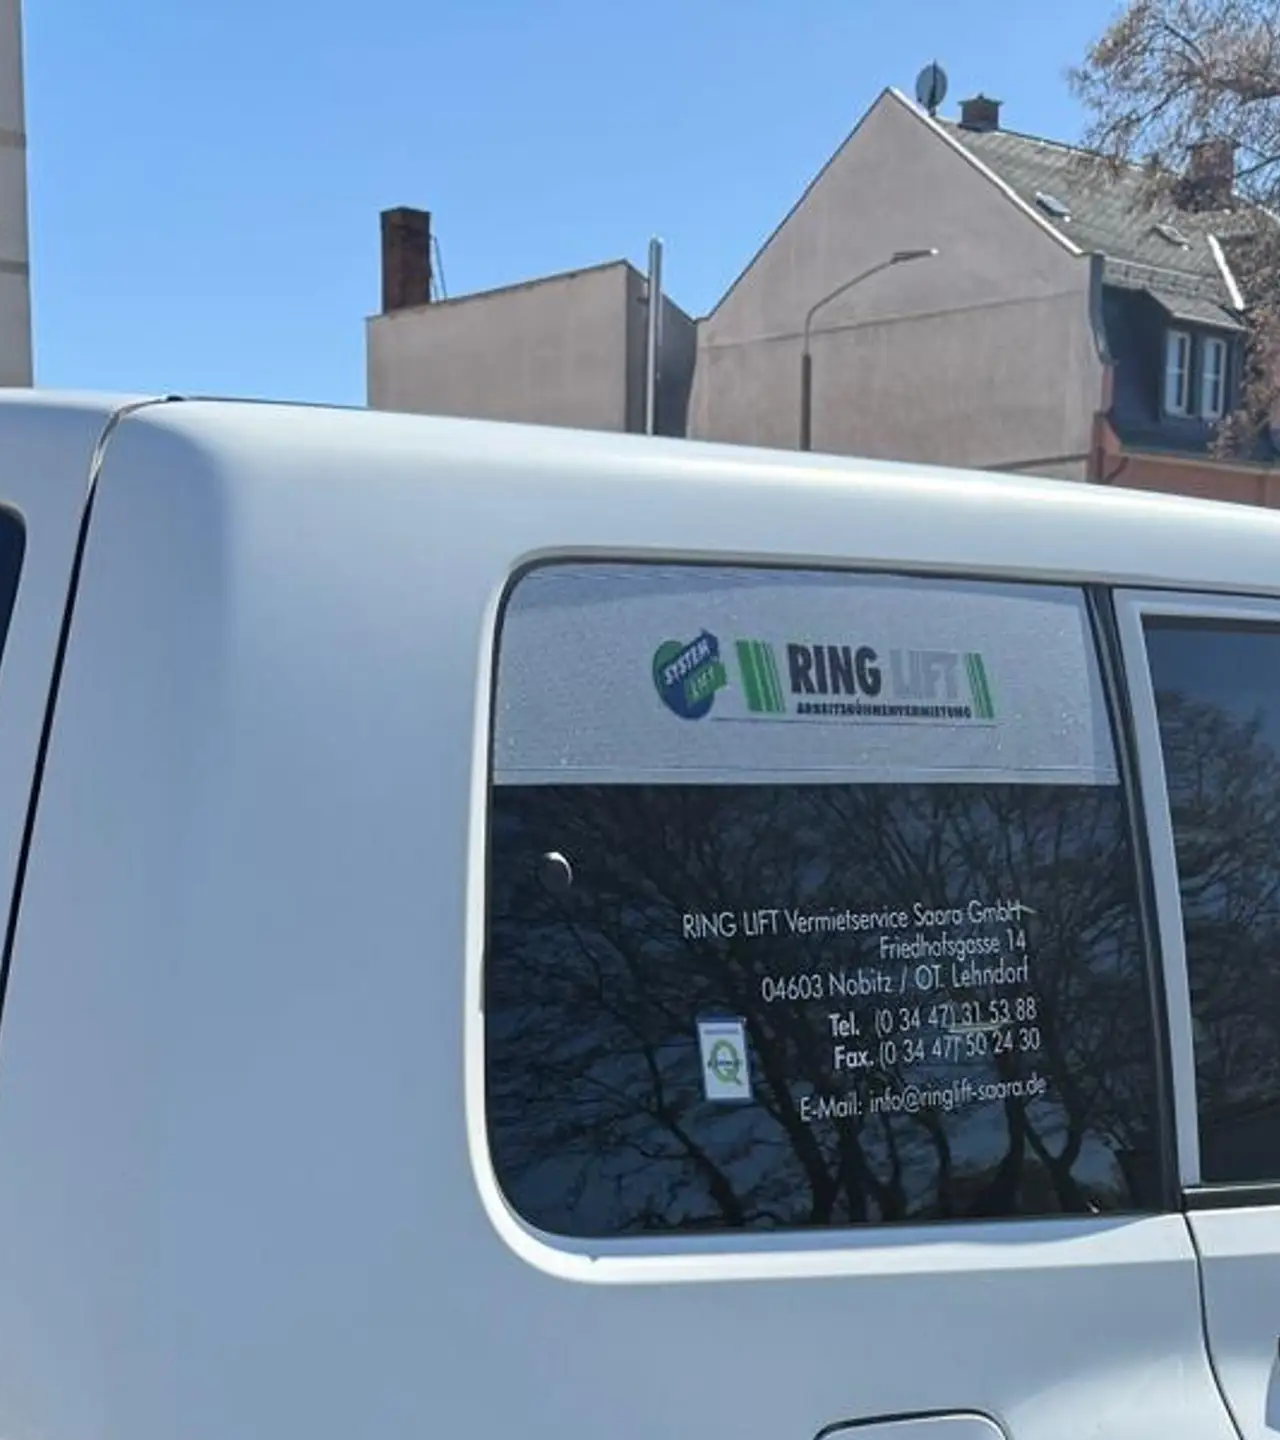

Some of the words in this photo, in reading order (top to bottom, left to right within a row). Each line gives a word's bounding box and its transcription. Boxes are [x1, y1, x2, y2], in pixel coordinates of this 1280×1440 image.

[664, 639, 710, 685] SYSTEM
[787, 643, 881, 697] RING
[889, 648, 960, 699] LIFT
[682, 911, 738, 939] RING
[743, 908, 780, 936] LIFT
[784, 905, 908, 934] Vermietservice
[913, 902, 963, 926] Saara
[968, 899, 1022, 924] GmbH
[1006, 927, 1026, 951] 14
[761, 973, 823, 1002] 04603
[829, 966, 893, 996] Nobitz
[898, 964, 908, 995] /
[951, 953, 1029, 988] Lehndorf
[829, 1011, 860, 1037] Tel.
[875, 1009, 894, 1038] (0
[899, 1007, 920, 1032] 34
[961, 1001, 981, 1026] 31
[989, 998, 1011, 1024] 53
[1015, 996, 1038, 1021] 88
[834, 1045, 874, 1070] Fax.
[880, 1041, 897, 1071] (0
[903, 1038, 924, 1063] 34
[966, 1032, 988, 1058] 50
[992, 1030, 1014, 1055] 24
[1020, 1027, 1041, 1051] 30
[800, 1090, 862, 1121] E-Mail:
[870, 1072, 1048, 1114] info@ringlift-saara.de
